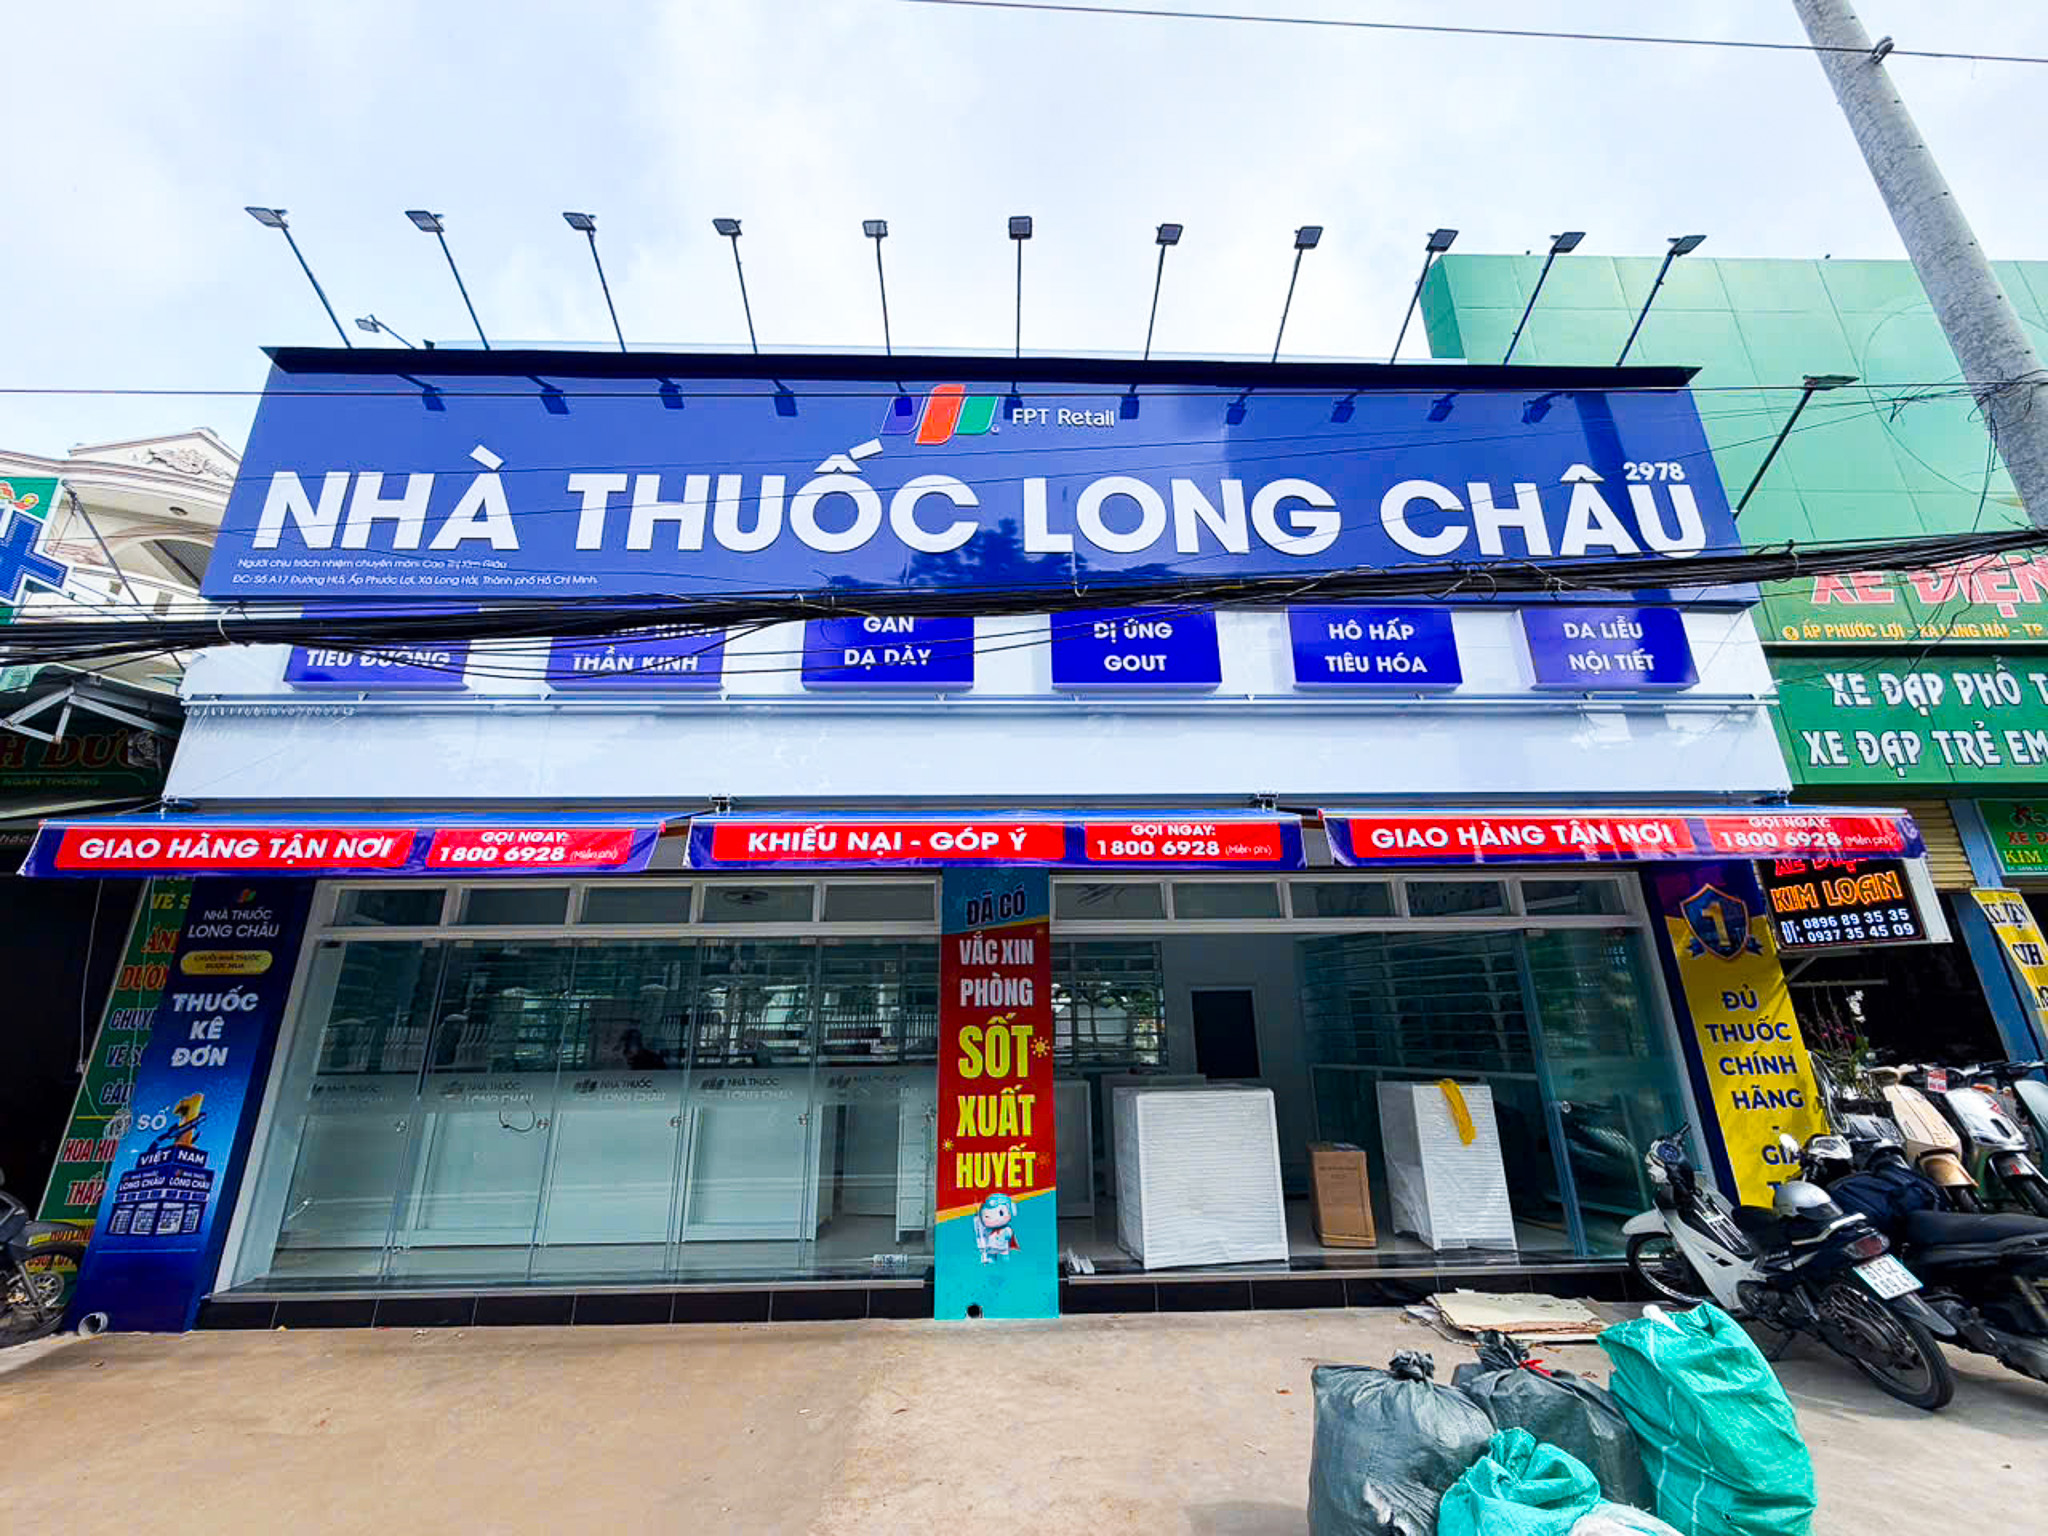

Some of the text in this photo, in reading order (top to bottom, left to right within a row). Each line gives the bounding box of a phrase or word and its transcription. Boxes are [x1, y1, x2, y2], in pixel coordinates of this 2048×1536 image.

[1012, 407, 1115, 427] FPT Retail
[1623, 461, 1687, 482] 2978
[252, 438, 1707, 559] NHÀ THUỐC LONG CHÂU
[862, 615, 915, 633] GAN
[1328, 617, 1415, 640] HÔ HẤP
[1563, 616, 1644, 640] DA LIỄU
[640, 655, 699, 672] KINH
[843, 648, 877, 671] DẠ
[1103, 654, 1168, 672] GOUT
[1324, 652, 1428, 674] TIÊU HÓA
[1568, 648, 1656, 676] NỘI TIẾT
[1824, 671, 1945, 718] XE ĐẠP
[1801, 719, 2048, 778] XE ĐẠP TRẺ EM
[1130, 823, 1217, 839] GỌI NGAY:
[1371, 825, 1449, 849] GIAO
[1459, 820, 1546, 848] HÀNG
[1616, 821, 1676, 845] NƠI
[1747, 816, 1780, 831] GỌI
[79, 830, 393, 868] GIAO HÀNG TẬN NƠI
[480, 831, 515, 846] GỌI
[747, 824, 838, 853] KHIẾU
[847, 831, 903, 858] NẠI
[928, 824, 1000, 852] GÓP
[1008, 826, 1028, 851] Ý
[1096, 839, 1156, 857] 1800
[1160, 839, 1221, 857] 6928
[1719, 831, 1780, 848] 1800
[1784, 831, 1844, 848] 6928
[438, 846, 499, 863] 1800
[503, 846, 566, 863] 6928
[2002, 848, 2044, 864] KIM
[1769, 869, 1905, 914] KIM LOAN
[203, 905, 274, 921] NHÀ THUỐC
[966, 883, 1027, 927] ĐÃ CÓ
[187, 920, 281, 939] LONG CHÂU
[1802, 915, 1838, 930] 0896
[1840, 912, 1861, 927] 89
[1863, 909, 1885, 924] 35
[1887, 907, 1911, 922] 35
[1807, 922, 1915, 944] 0937 35 45 09
[958, 930, 1035, 966] VẮC XIN
[172, 985, 259, 1013] THUỐC
[959, 971, 1034, 1008] PHÒNG
[1721, 984, 1760, 1010] ĐỦ
[189, 1017, 225, 1041] KÊ
[1704, 1015, 1793, 1043] THUỐC
[170, 1046, 230, 1067] ĐƠN
[957, 1012, 1034, 1079] SỐT
[1718, 1051, 1798, 1076] CHÍNH
[1730, 1084, 1806, 1110] HÃNG
[136, 1105, 171, 1131] SỐ
[956, 1083, 1037, 1137] XUẤT
[176, 1149, 206, 1165] NAM
[955, 1142, 1037, 1189] HUYẾT
